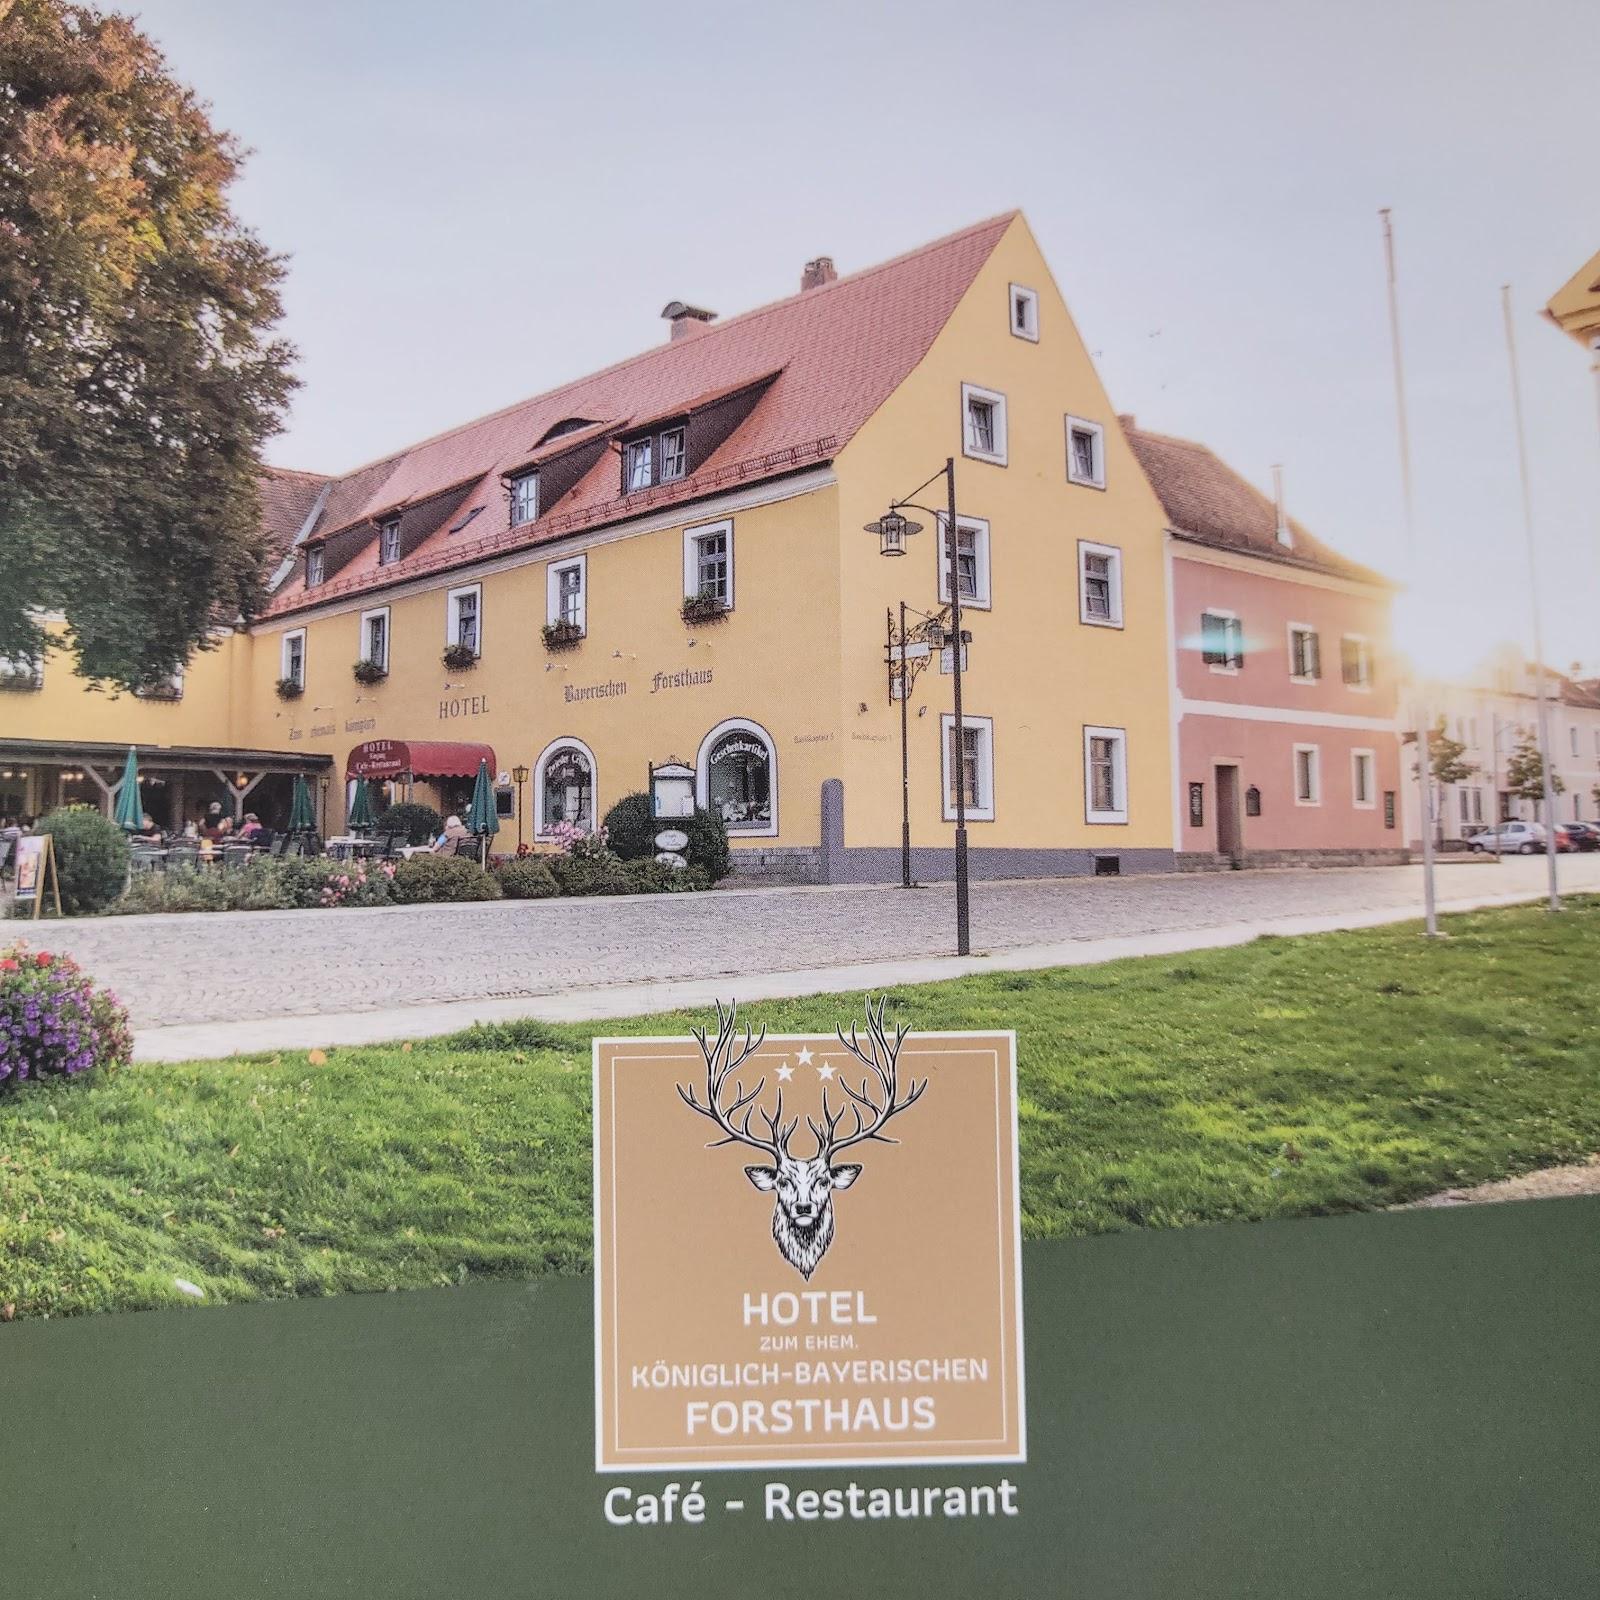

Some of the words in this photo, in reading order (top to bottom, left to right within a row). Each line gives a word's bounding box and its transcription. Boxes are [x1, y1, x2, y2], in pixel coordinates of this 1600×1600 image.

[650, 667, 714, 694] Forsthaus
[439, 694, 490, 719] HOTEL
[742, 1289, 878, 1327] HOTEL
[759, 1335, 799, 1352] ZUM
[804, 1333, 858, 1350] EHEM.
[631, 1358, 988, 1388] KÖNIGLICH-BAYERISCHEN
[686, 1396, 937, 1436] FORSTHAUS
[603, 1481, 706, 1526] Café
[764, 1478, 1020, 1521] Restaurant
